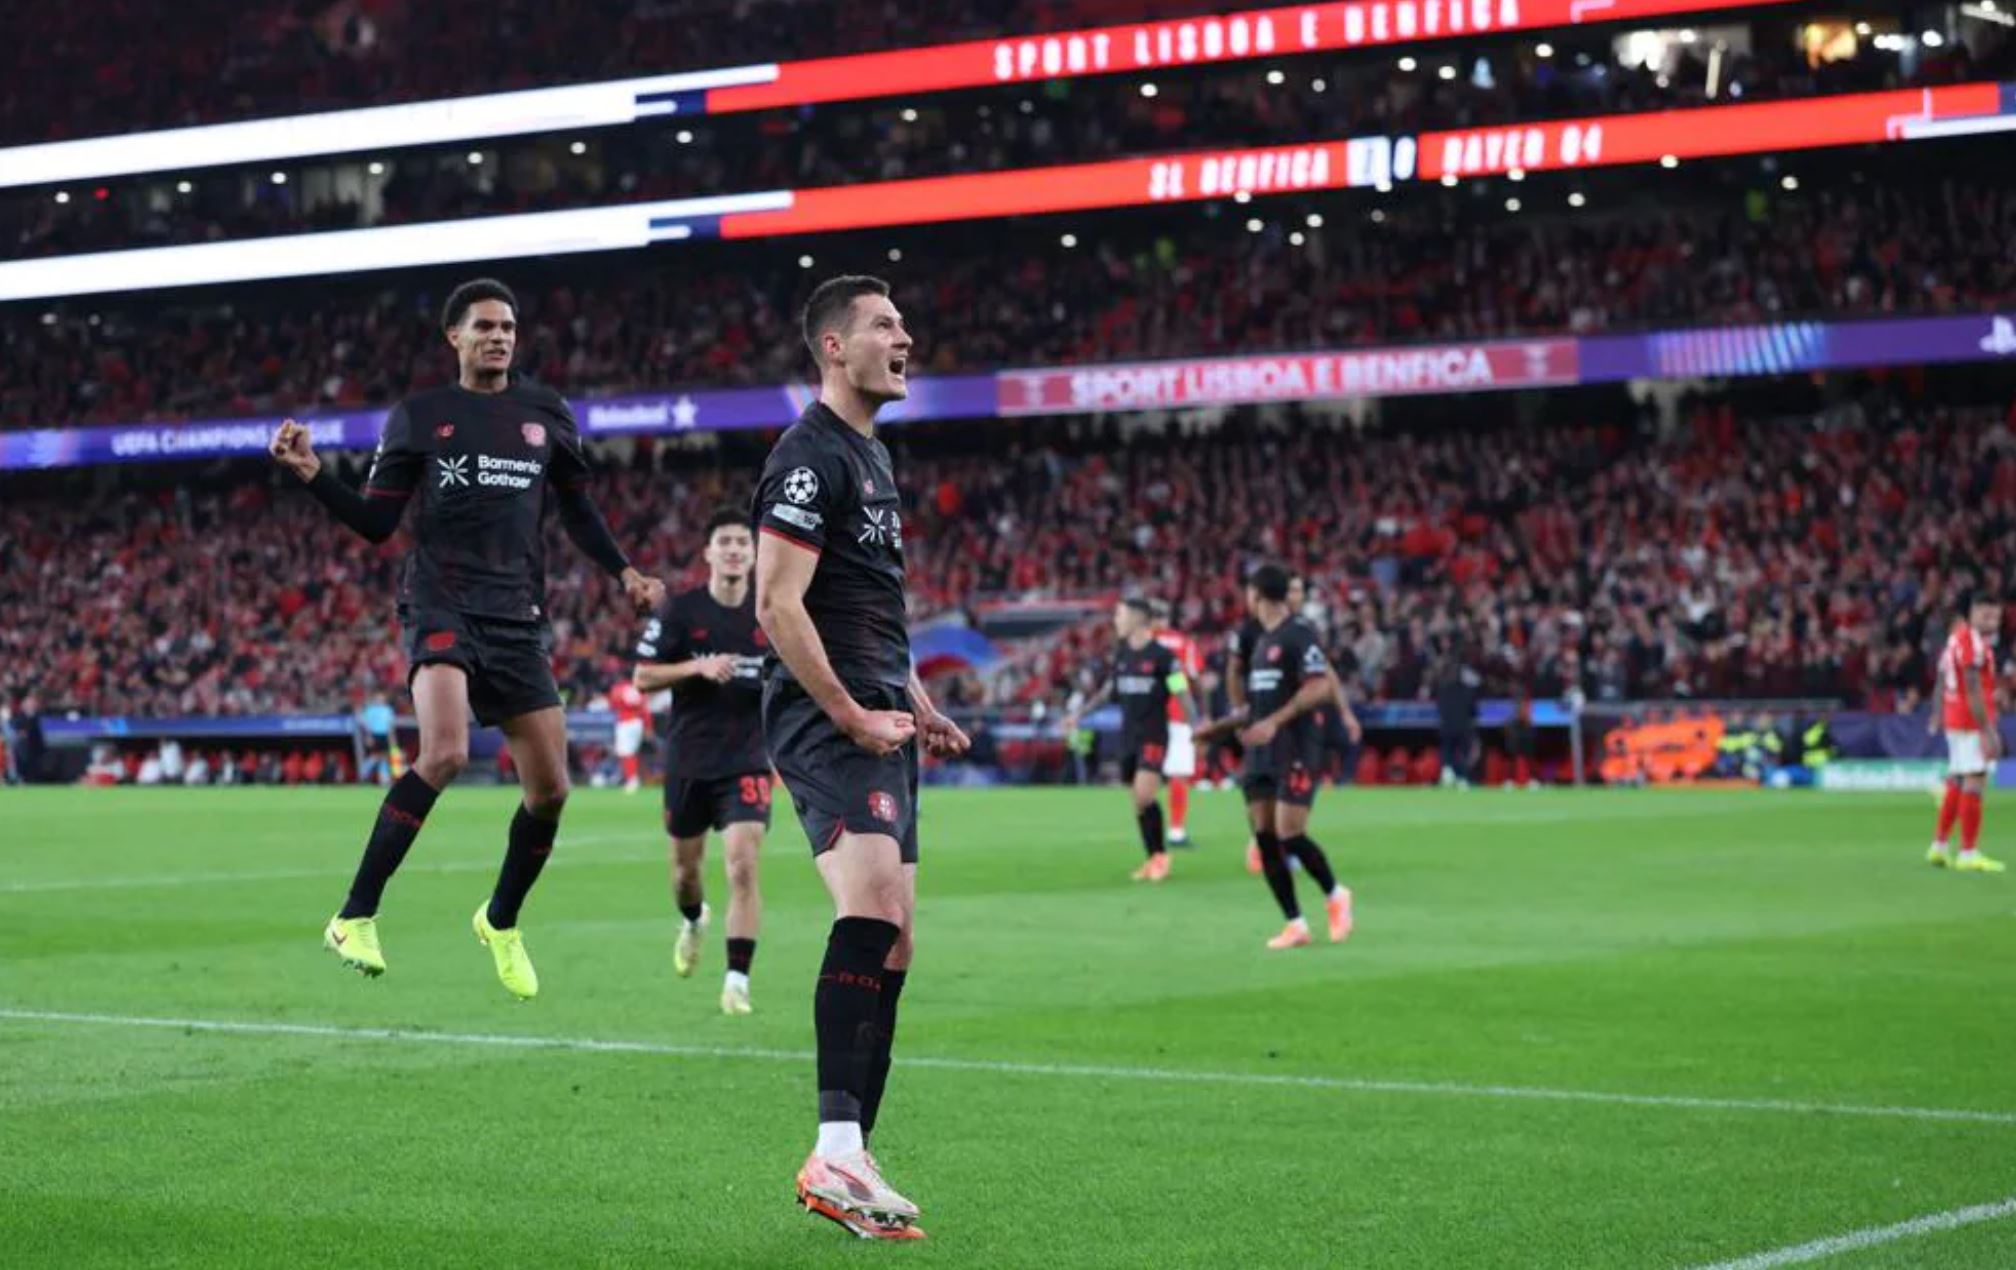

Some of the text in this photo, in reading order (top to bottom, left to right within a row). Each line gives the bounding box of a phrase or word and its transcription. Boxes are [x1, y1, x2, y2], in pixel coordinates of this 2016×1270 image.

[994, 0, 1520, 80] SPORT LISBOA E BENFICA
[1200, 149, 1329, 195] BENFICA
[1442, 128, 1545, 173] BAYER
[1560, 124, 1603, 165] 04
[1071, 346, 1495, 411] SPORT LISBOA E BENFICA
